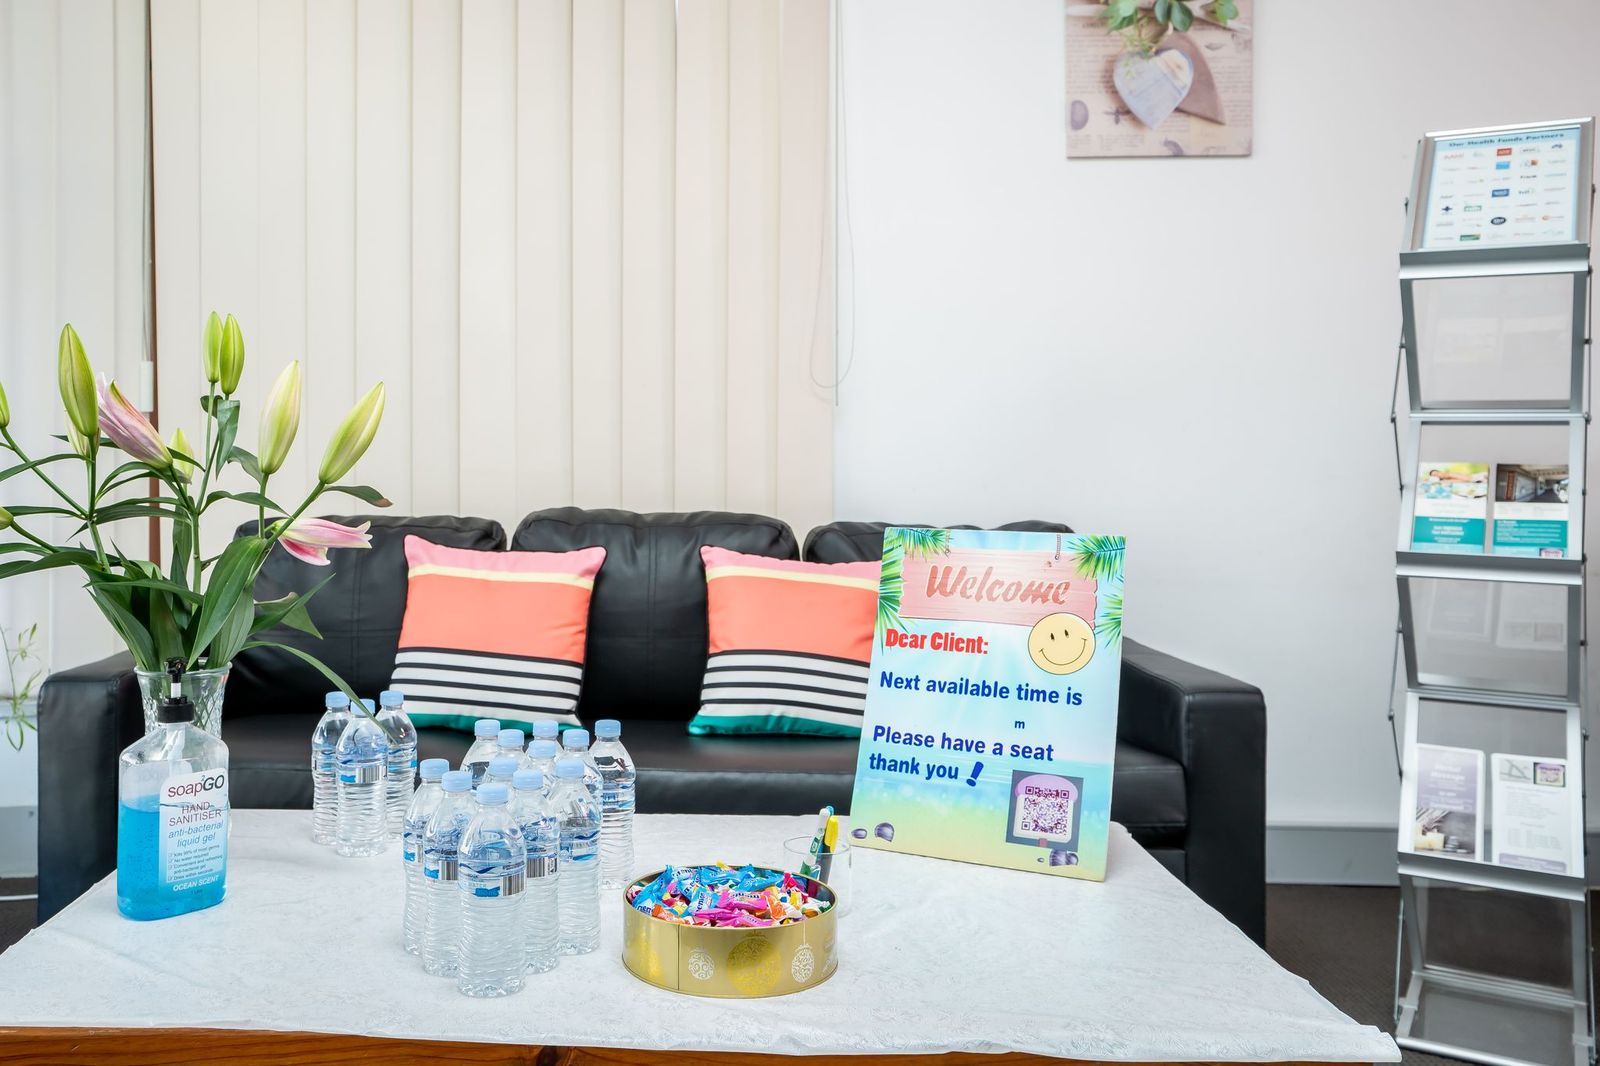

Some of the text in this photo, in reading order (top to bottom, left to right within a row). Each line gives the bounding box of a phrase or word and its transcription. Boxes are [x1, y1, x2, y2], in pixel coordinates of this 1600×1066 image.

[925, 565, 1070, 605] Welcome
[885, 628, 989, 655] Dear Client:
[879, 671, 1083, 706] Next available time is
[1014, 718, 1026, 729] m
[873, 725, 1055, 762] Please have a seat
[869, 753, 920, 776] thank
[926, 764, 959, 785] you
[169, 808, 222, 827] SANITISER
[181, 801, 211, 815] HAND
[168, 819, 224, 839] anti-bacterial
[176, 832, 216, 848] liquid gel
[172, 874, 219, 892] OCEAN SCENT
